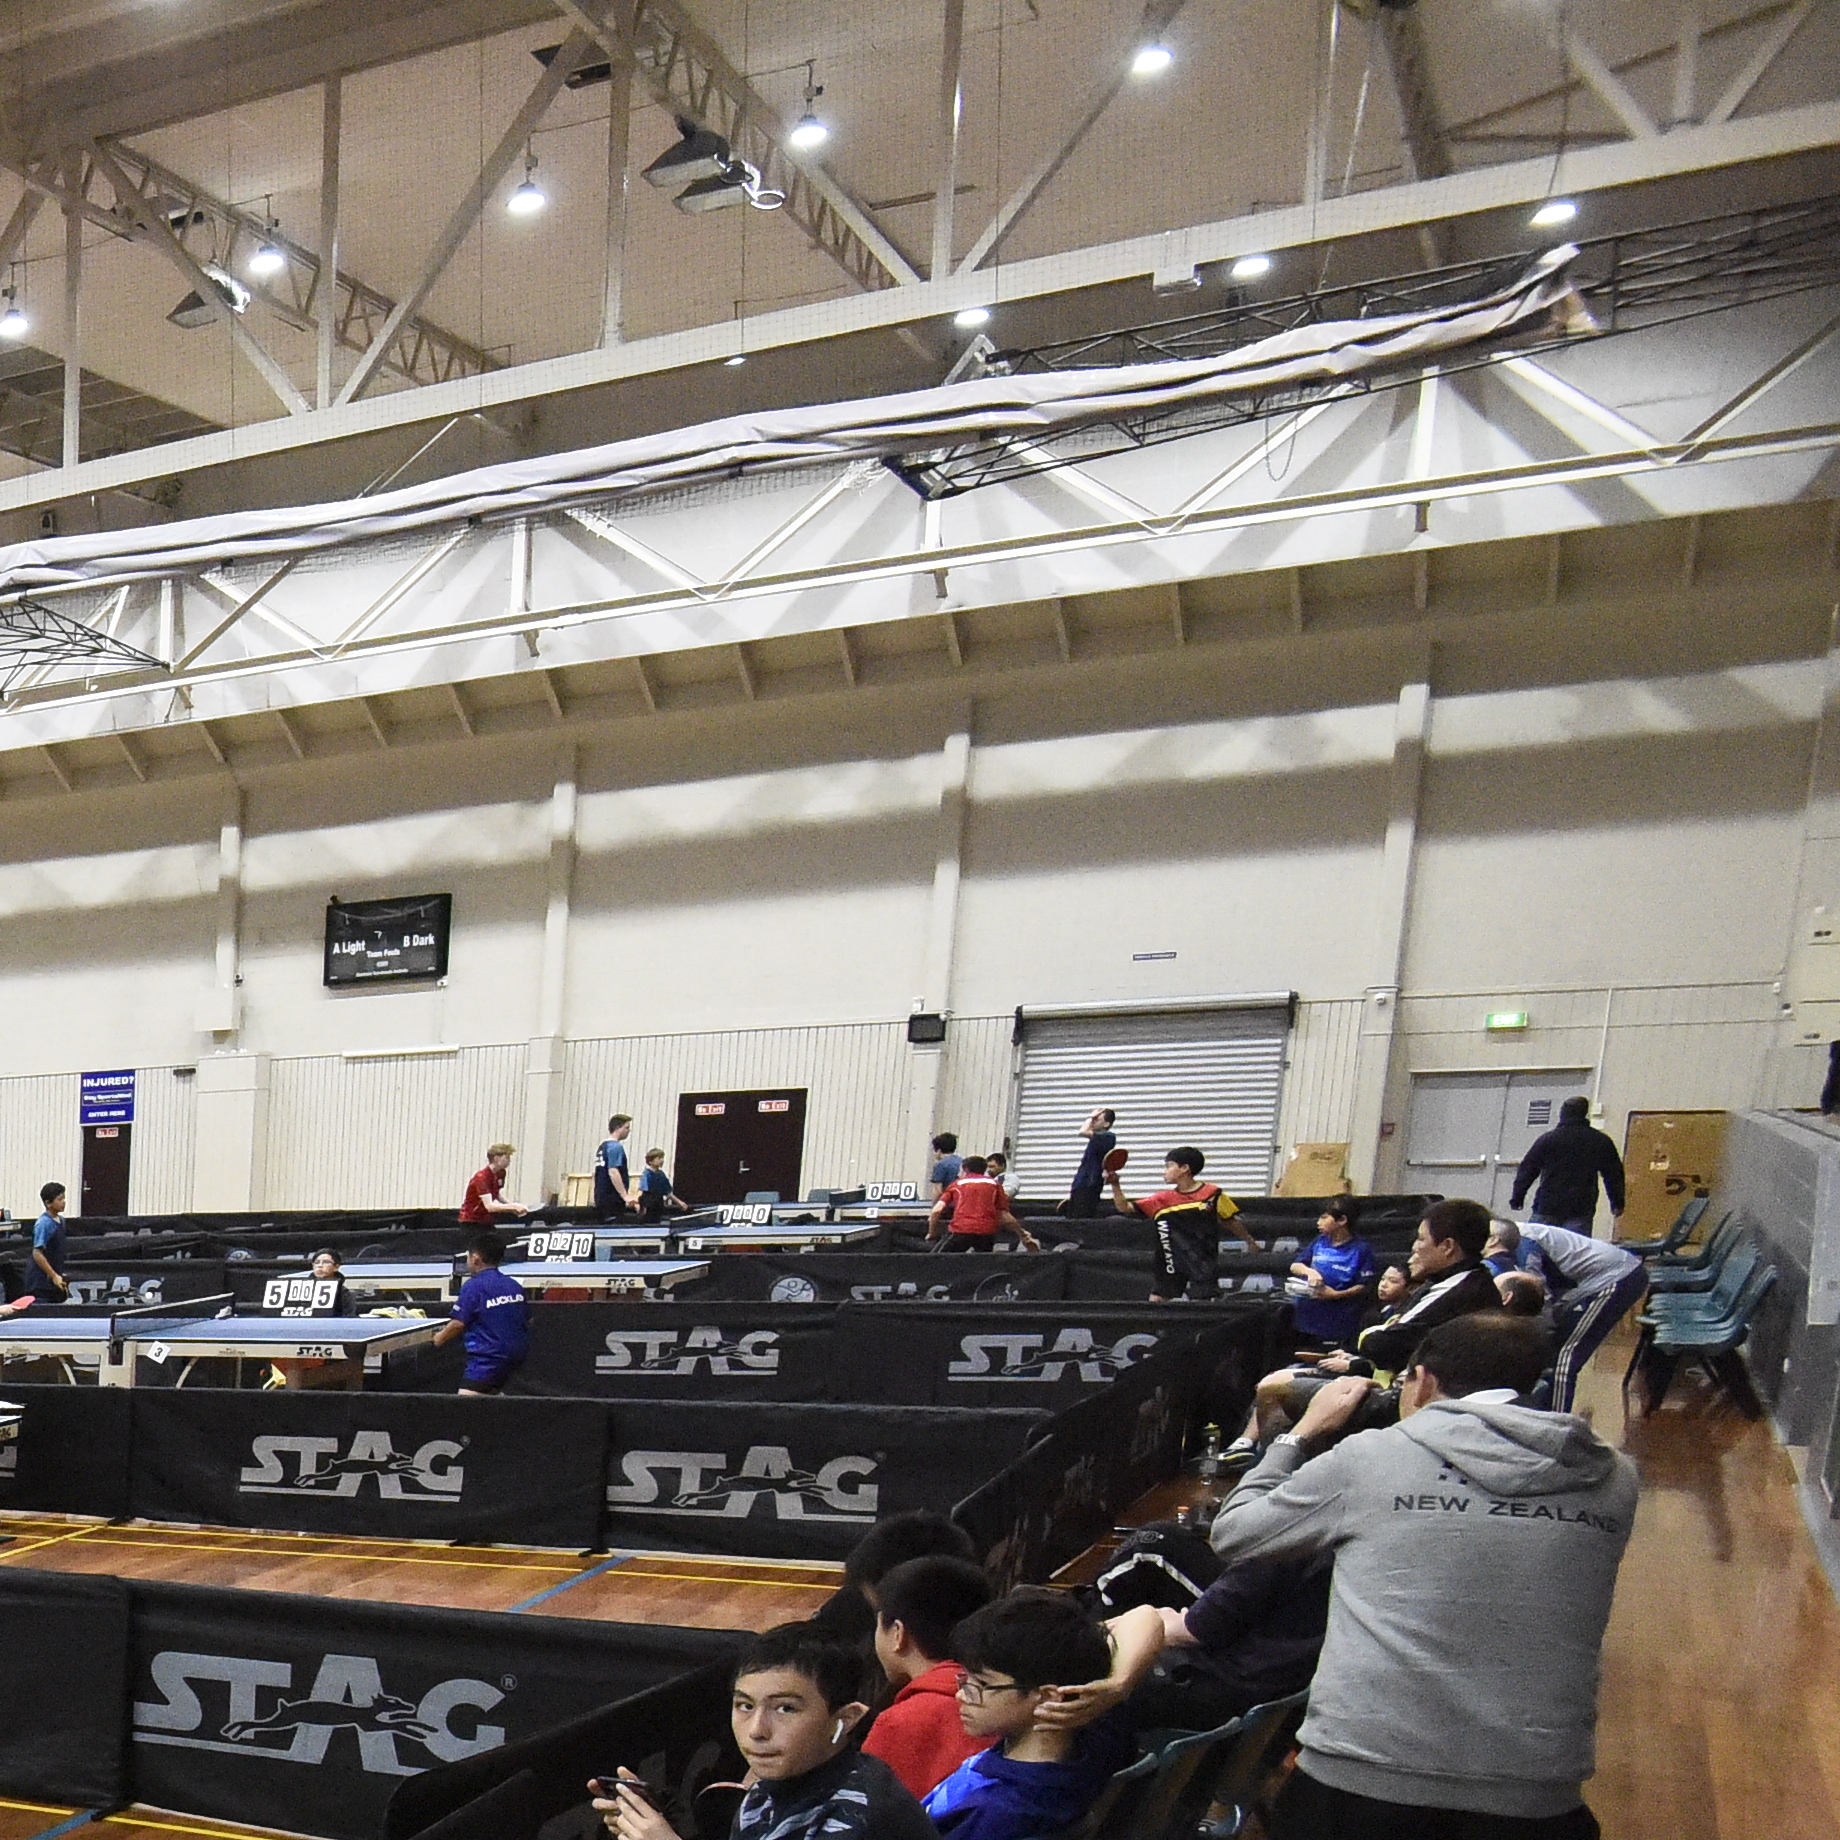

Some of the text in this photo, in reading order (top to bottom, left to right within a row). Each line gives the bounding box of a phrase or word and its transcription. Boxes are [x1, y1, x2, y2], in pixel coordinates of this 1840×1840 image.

[342, 940, 366, 955] Light
[412, 933, 435, 946] Dark
[83, 1076, 135, 1087] INJURED?
[870, 1186, 879, 1199] 0
[903, 1185, 912, 1198] 0
[756, 1207, 767, 1222] 0
[532, 1237, 590, 1255] 8 0 2 10
[1156, 1220, 1175, 1275] WAIKATO
[269, 1285, 282, 1306] 5
[317, 1285, 331, 1306] 5
[154, 1347, 164, 1358] 3
[296, 1346, 333, 1357] STAG
[596, 1325, 780, 1376] STAG
[948, 1328, 1160, 1382] STAG
[240, 1430, 465, 1502] STAG
[607, 1446, 880, 1524] STAG
[1393, 1495, 1618, 1534] NEW ZEALAND
[133, 1651, 507, 1776] STAG
